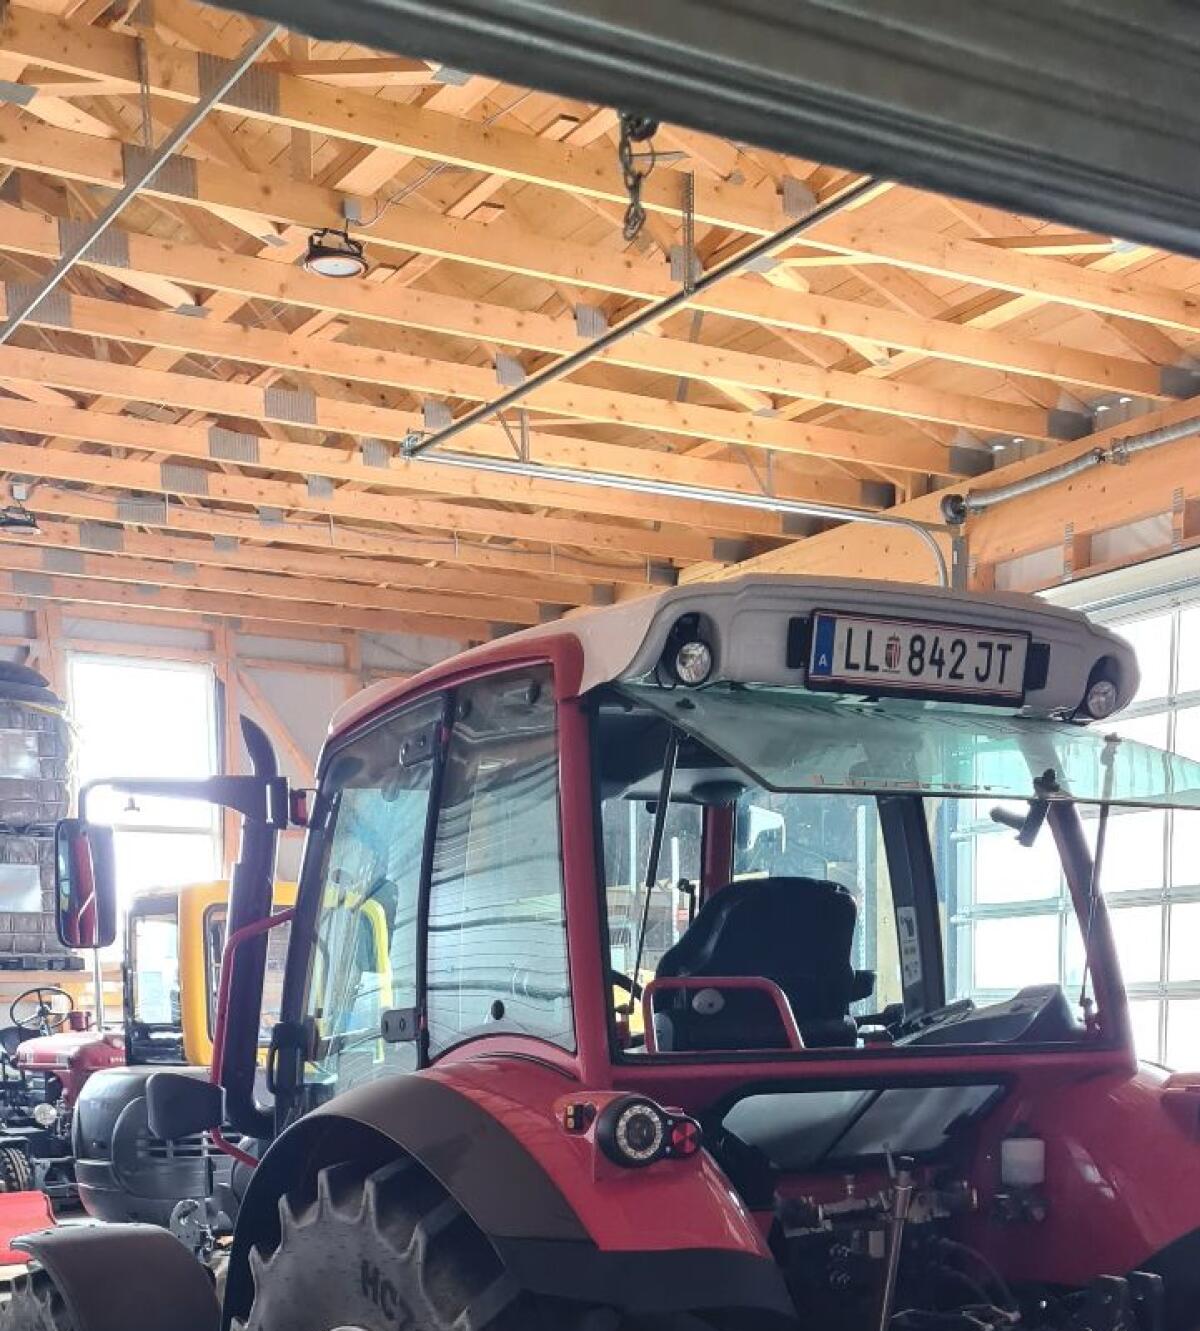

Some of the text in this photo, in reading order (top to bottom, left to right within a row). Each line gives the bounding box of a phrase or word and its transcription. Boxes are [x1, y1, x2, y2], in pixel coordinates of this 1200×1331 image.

[818, 656, 828, 667] A
[845, 628, 1013, 684] LL 842 JT
